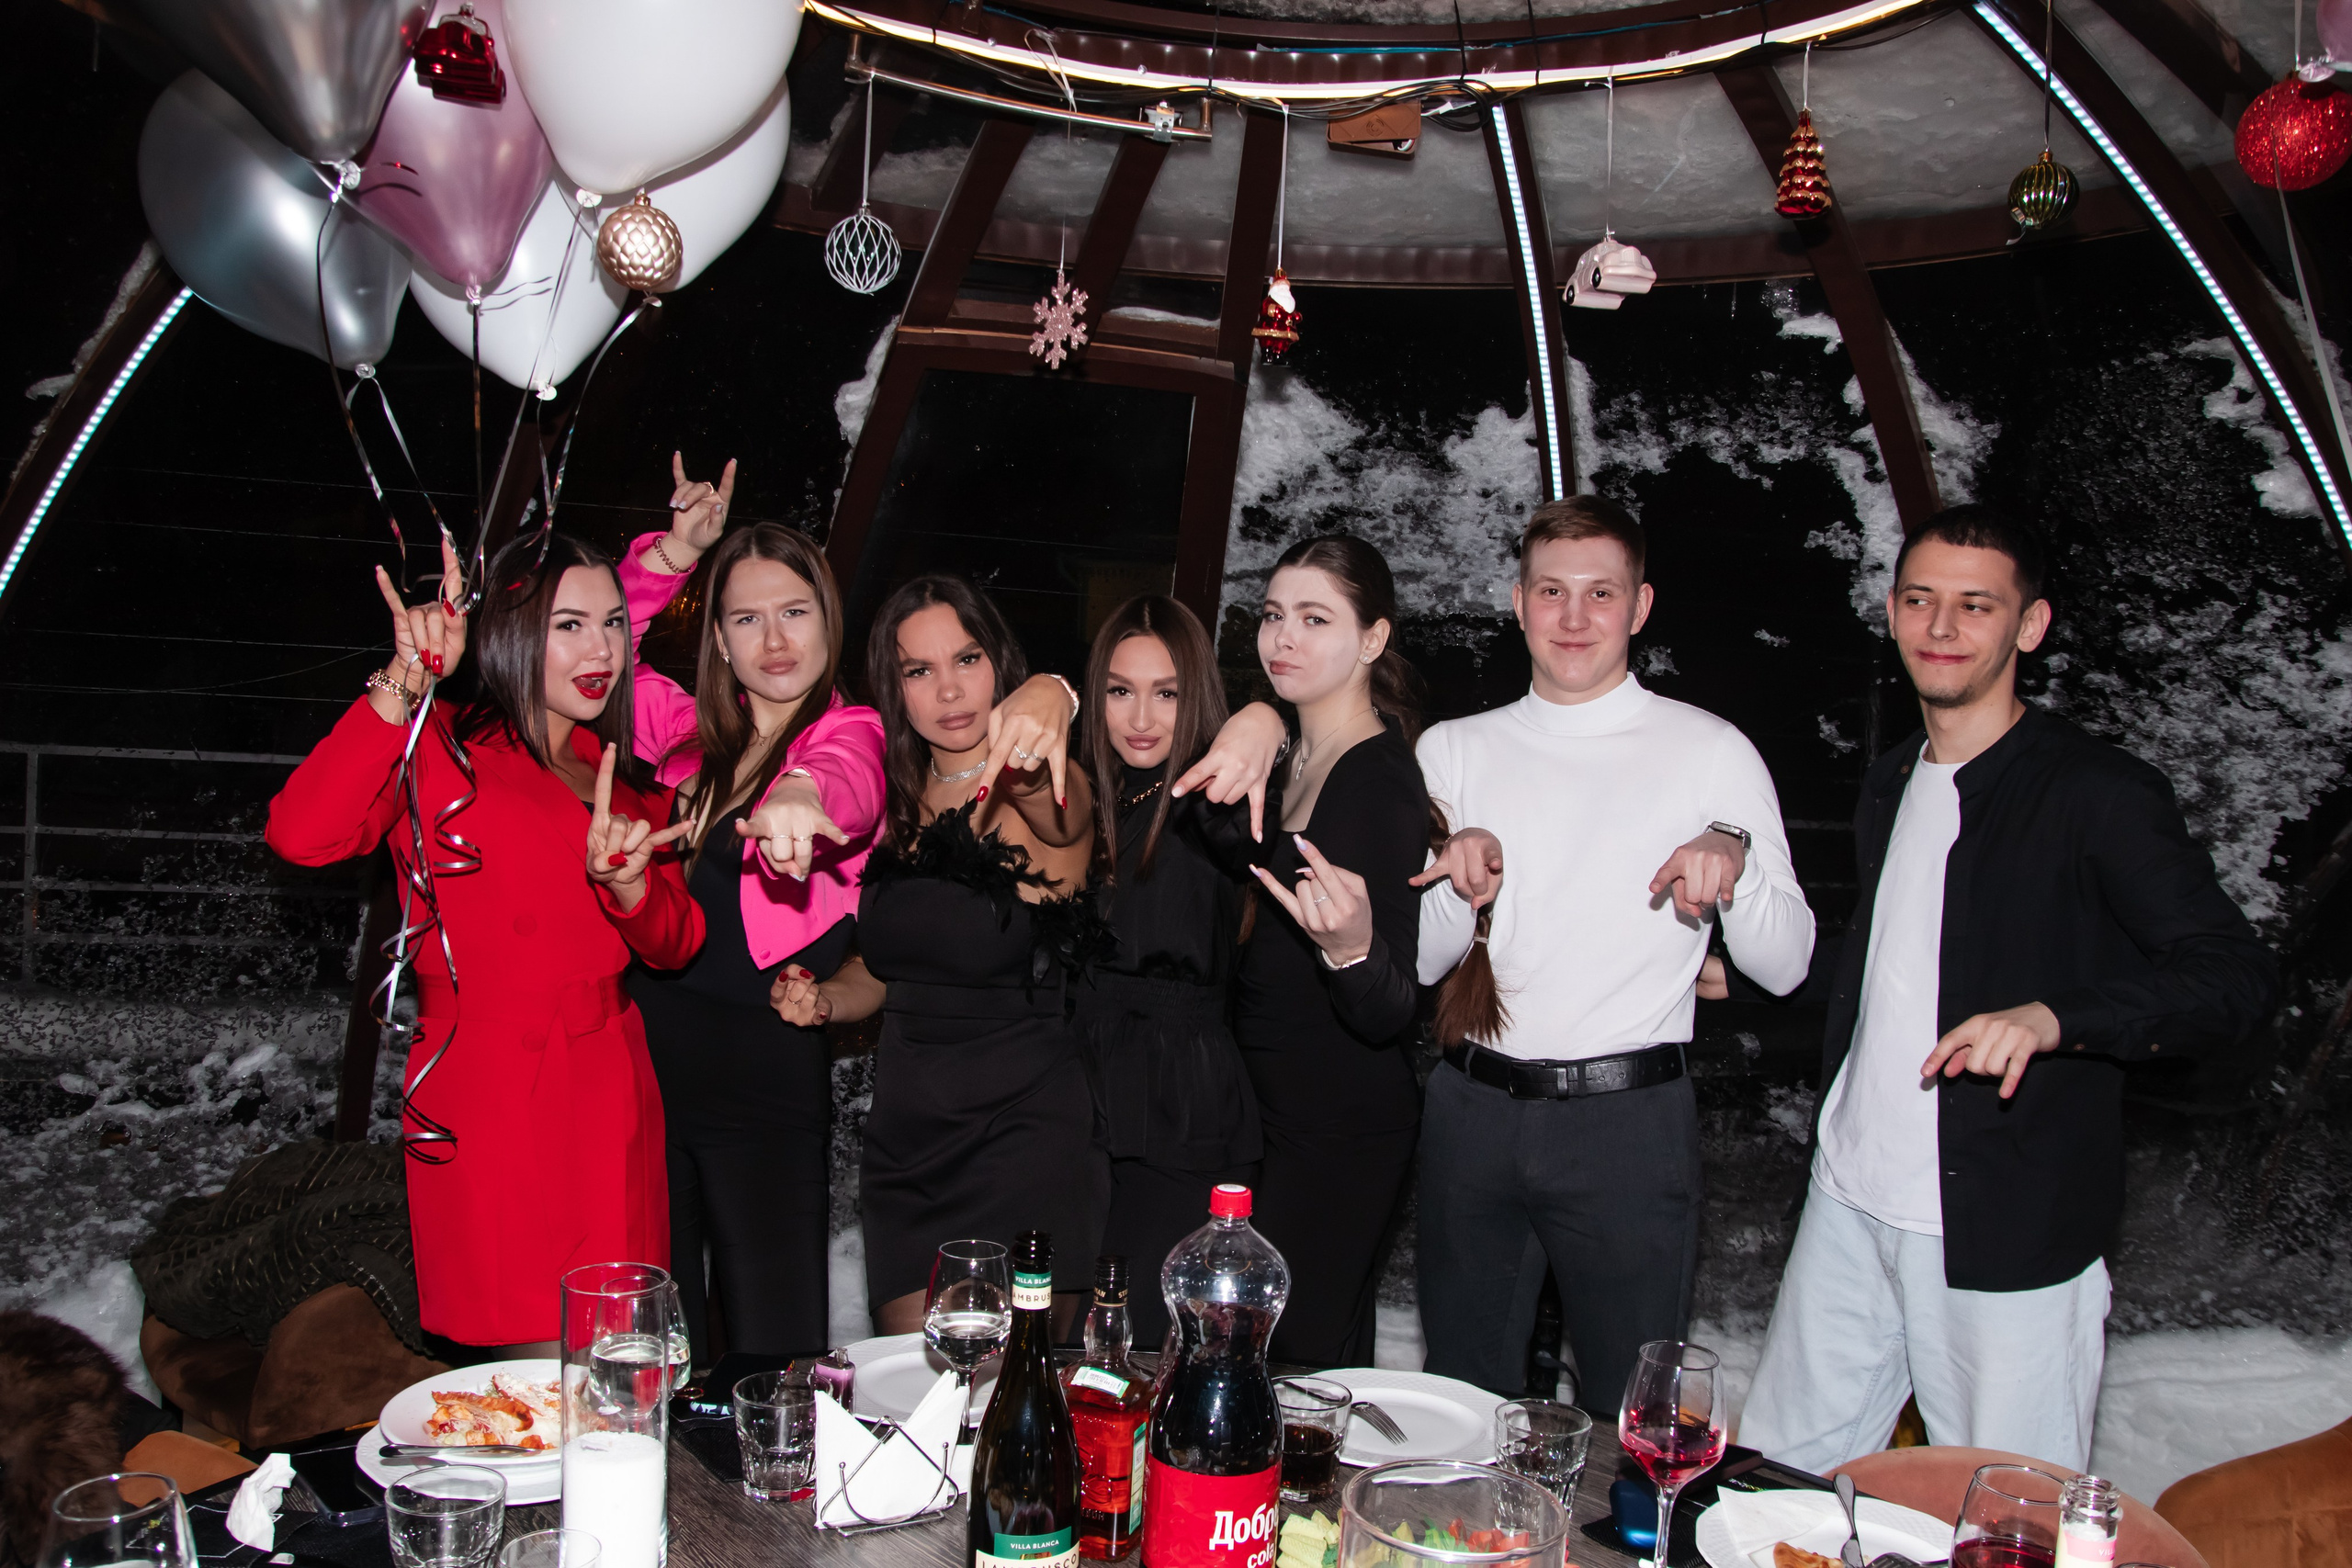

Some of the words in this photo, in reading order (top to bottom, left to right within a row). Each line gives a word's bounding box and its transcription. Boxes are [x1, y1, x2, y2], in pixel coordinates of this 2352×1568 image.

[1014, 1275, 1033, 1285] VILLA
[1034, 1275, 1052, 1285] BLANC
[1012, 1291, 1051, 1303] AMBRUS
[1208, 1502, 1279, 1551] Добр
[1032, 1539, 1060, 1550] BLANCA
[1247, 1542, 1275, 1568] cola
[2098, 1548, 2115, 1558] VILL
